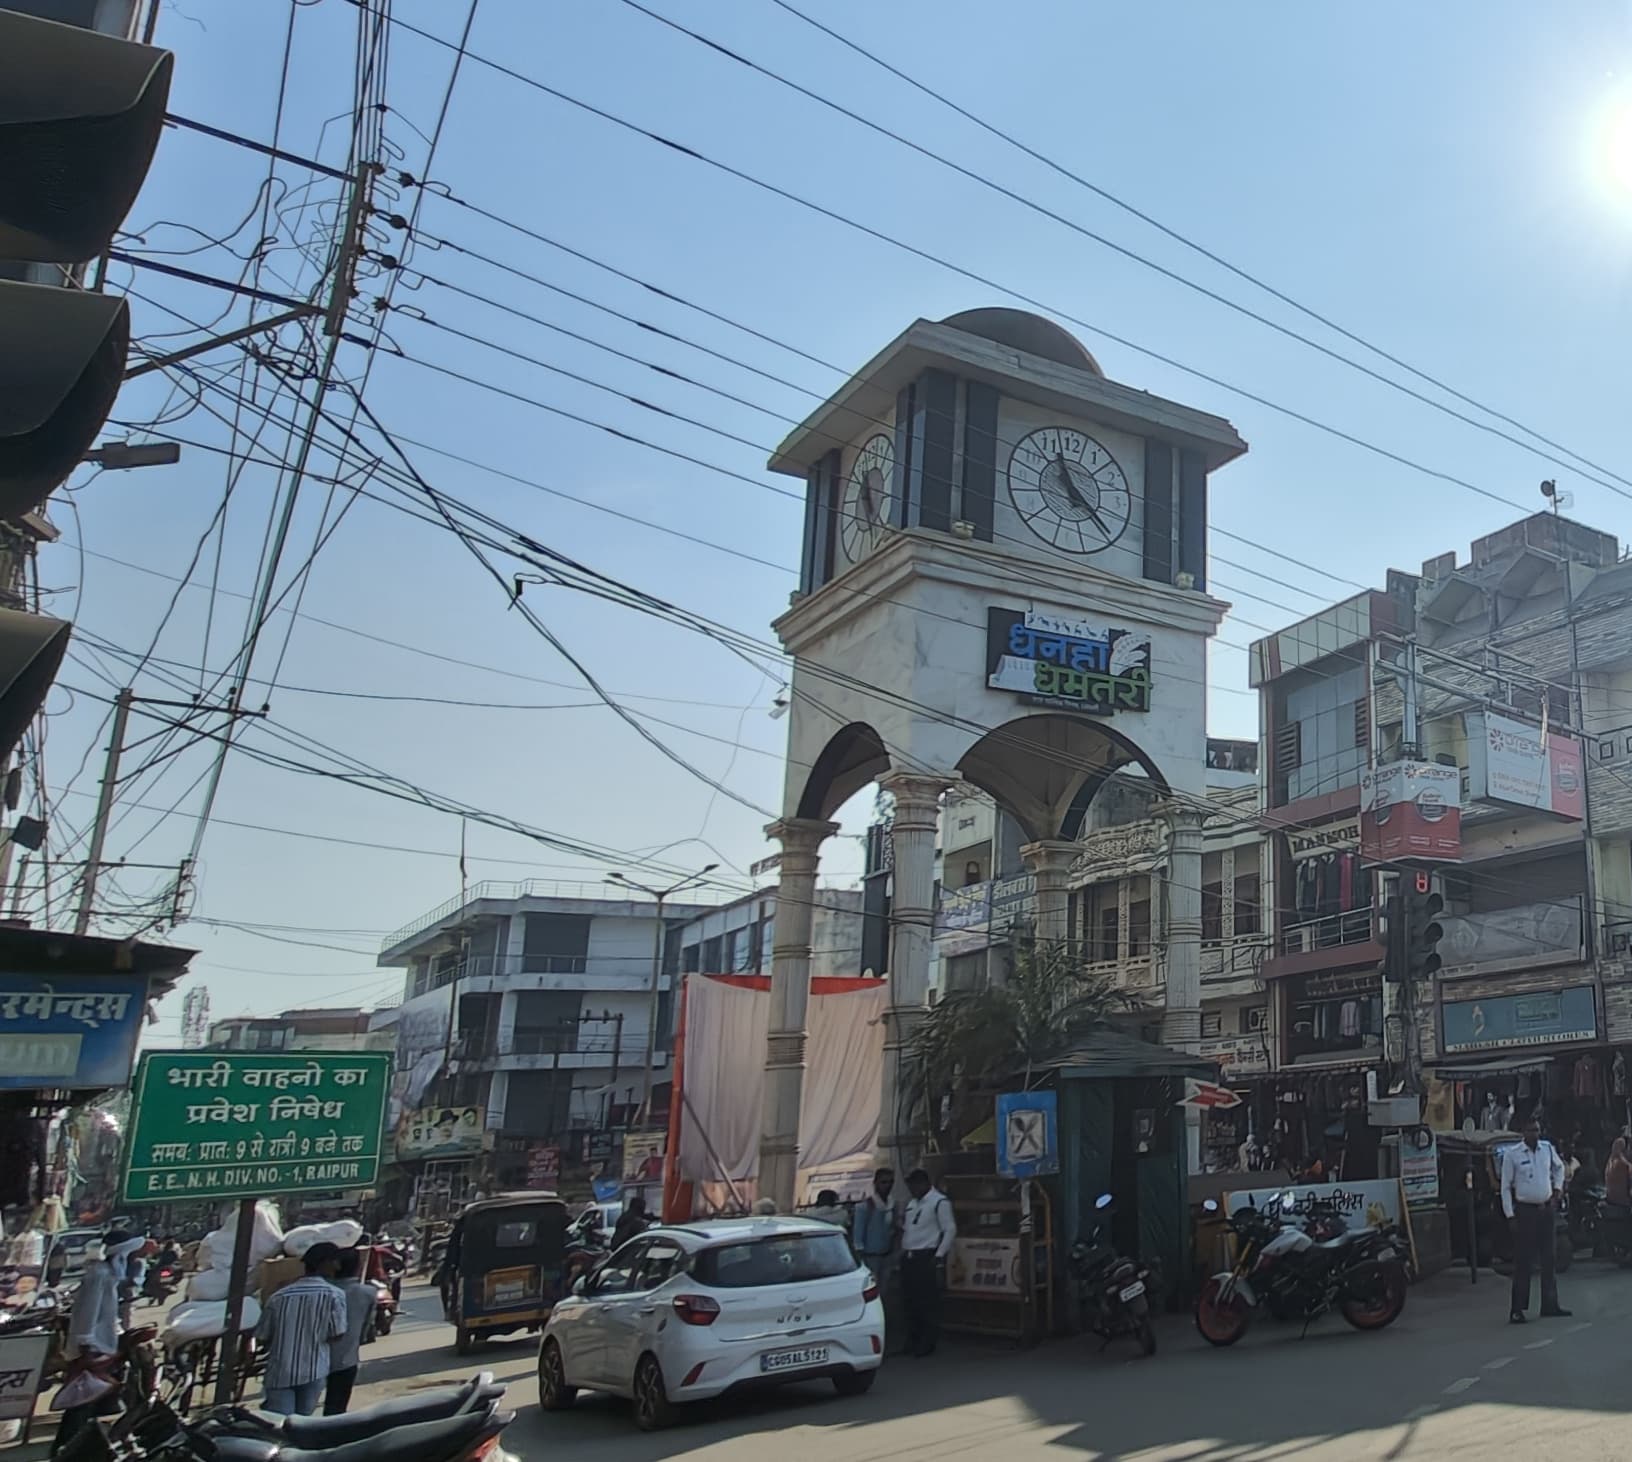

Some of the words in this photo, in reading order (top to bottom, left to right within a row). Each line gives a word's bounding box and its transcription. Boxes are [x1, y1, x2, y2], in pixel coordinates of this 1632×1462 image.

[1009, 623, 1109, 672] धनहा
[1034, 660, 1153, 710] धमतरी
[167, 1061, 234, 1088] भारी
[242, 1061, 325, 1089] वाहनो
[333, 1067, 369, 1087] का
[185, 1097, 260, 1124] प्रवेश
[270, 1094, 346, 1121] निषेध
[251, 1132, 265, 1158] से
[341, 1134, 365, 1153] तक
[224, 1169, 253, 1186] DIV.
[306, 1163, 359, 1181] RAIPUR
